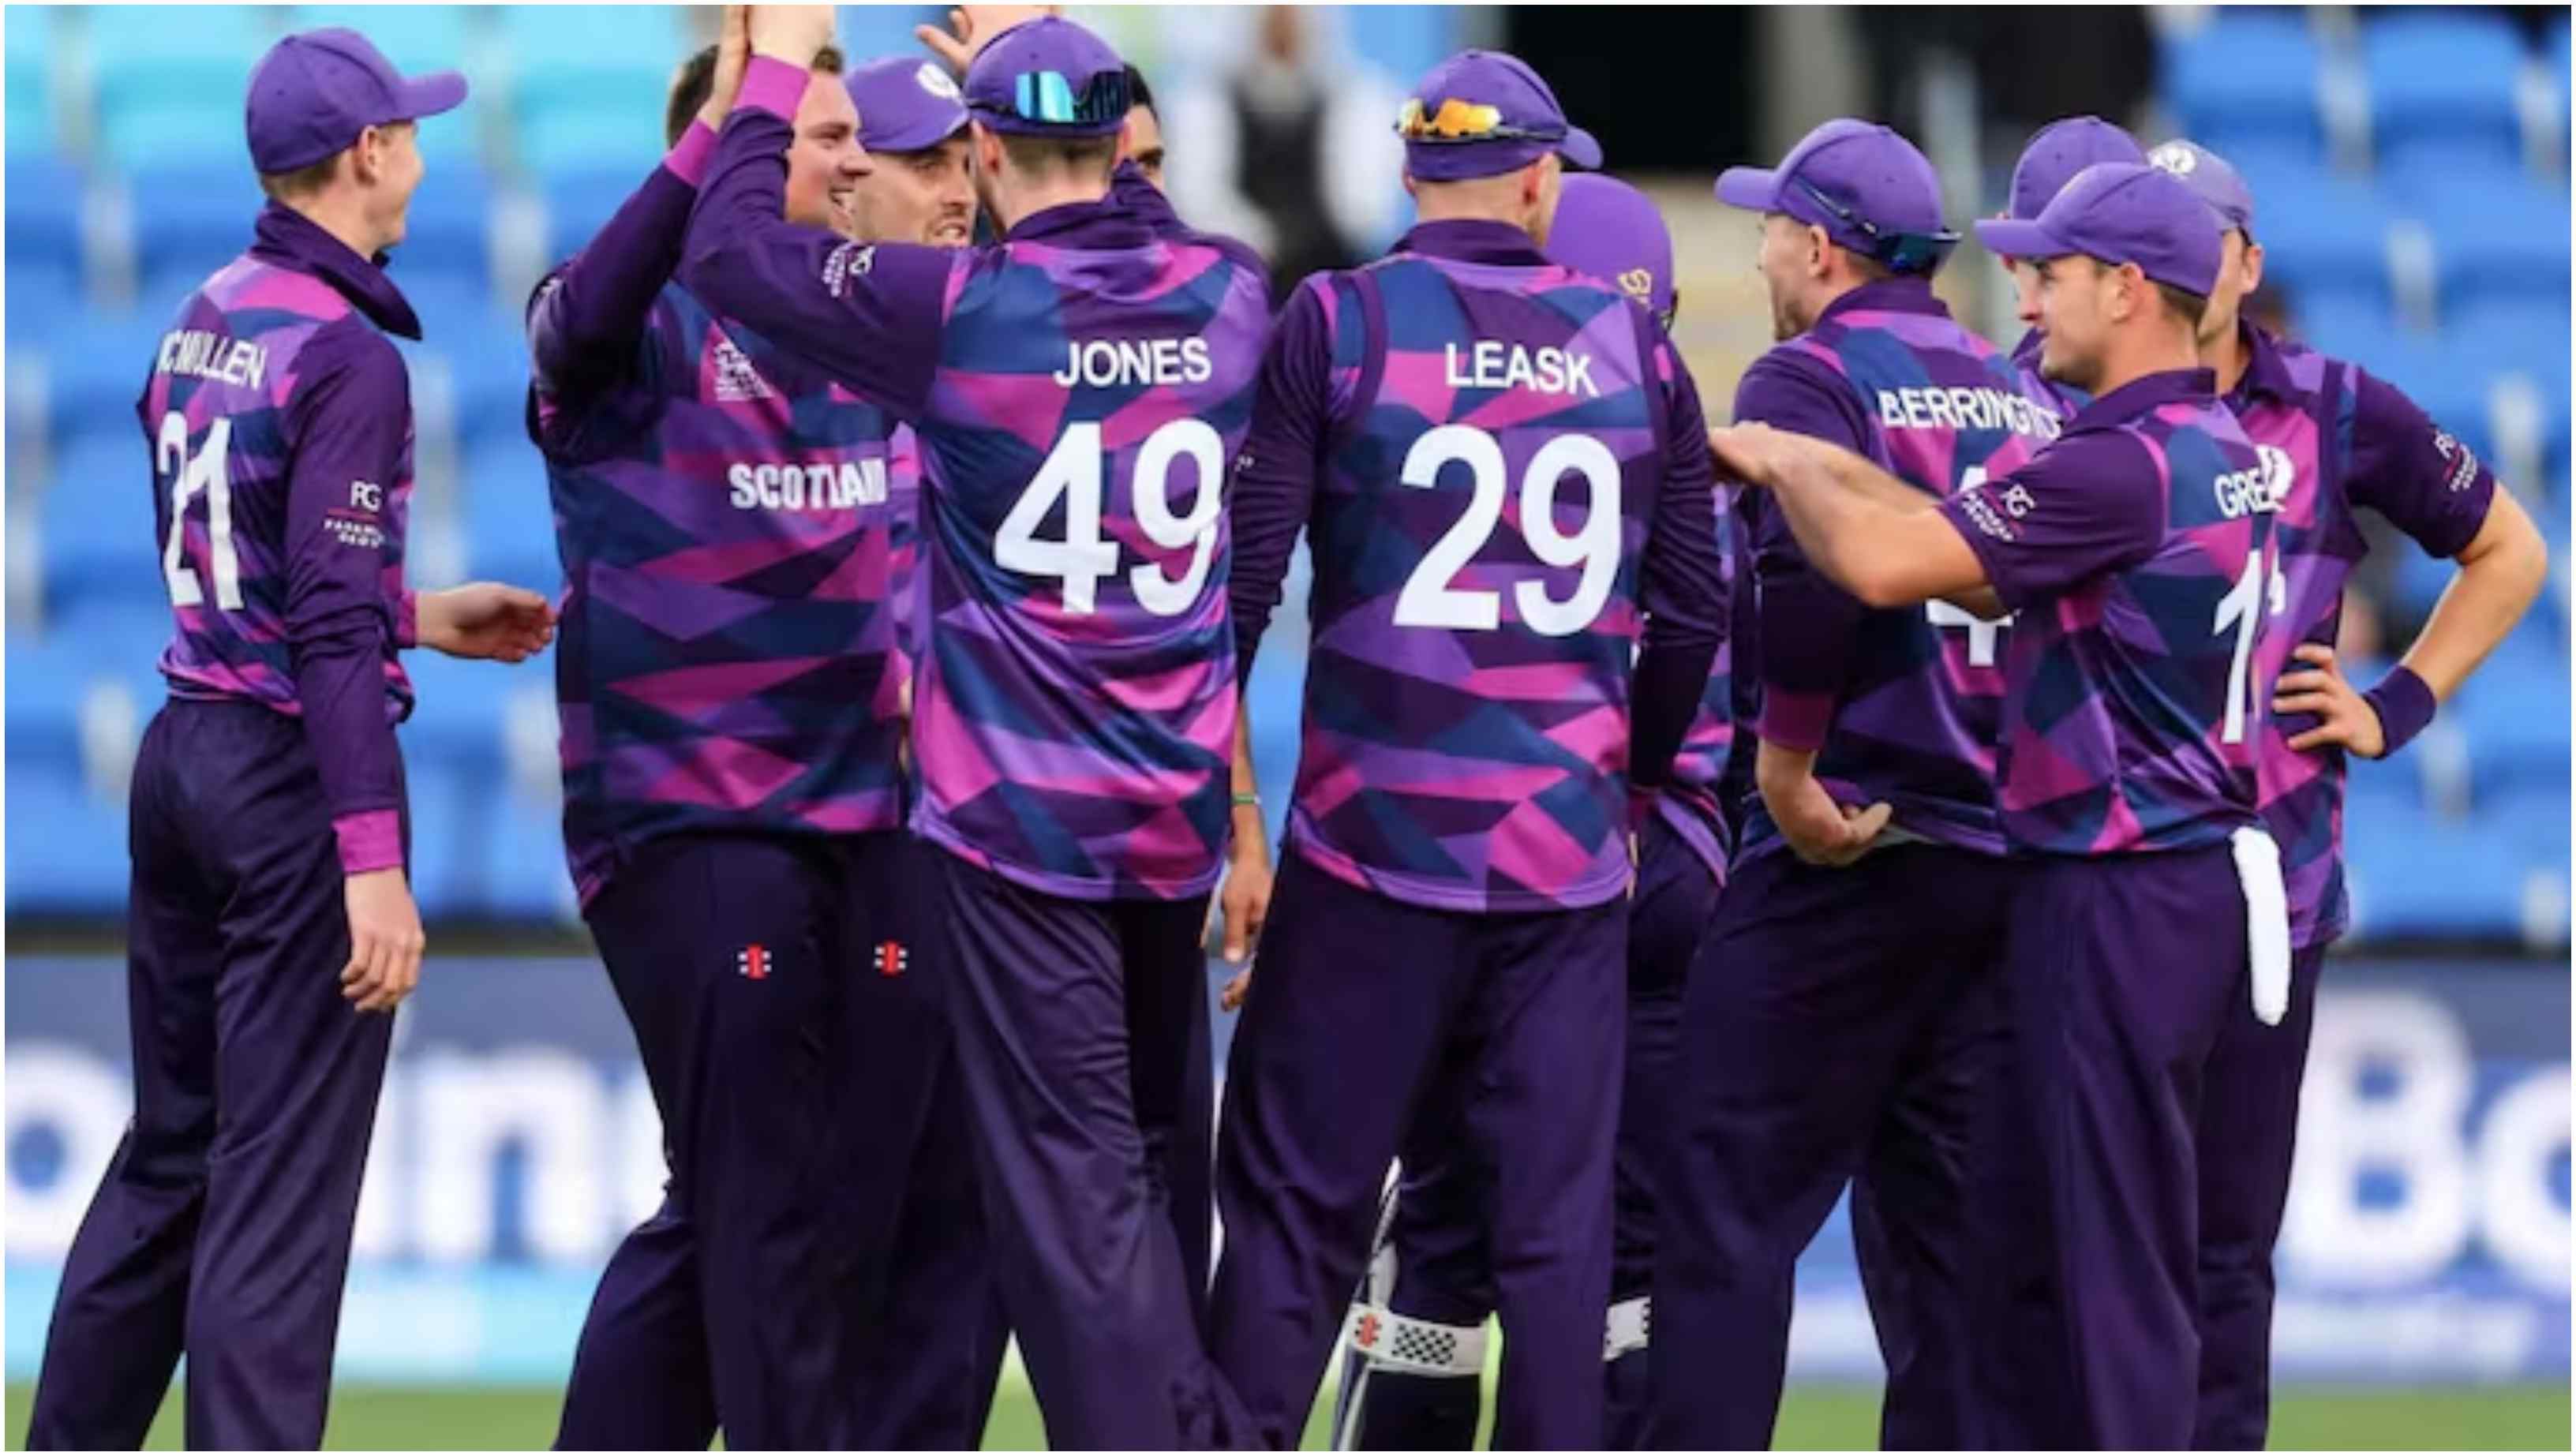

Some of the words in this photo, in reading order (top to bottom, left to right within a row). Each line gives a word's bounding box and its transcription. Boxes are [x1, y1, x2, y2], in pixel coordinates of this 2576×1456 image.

[1054, 338, 1212, 387] JONES
[1445, 342, 1600, 398] LEASK
[1878, 386, 2061, 440] BERRINGTO
[158, 410, 244, 610] 21
[994, 417, 1226, 616] 49
[1392, 424, 1622, 636] 29
[2215, 469, 2276, 519] GRE
[2213, 550, 2263, 743] 1
